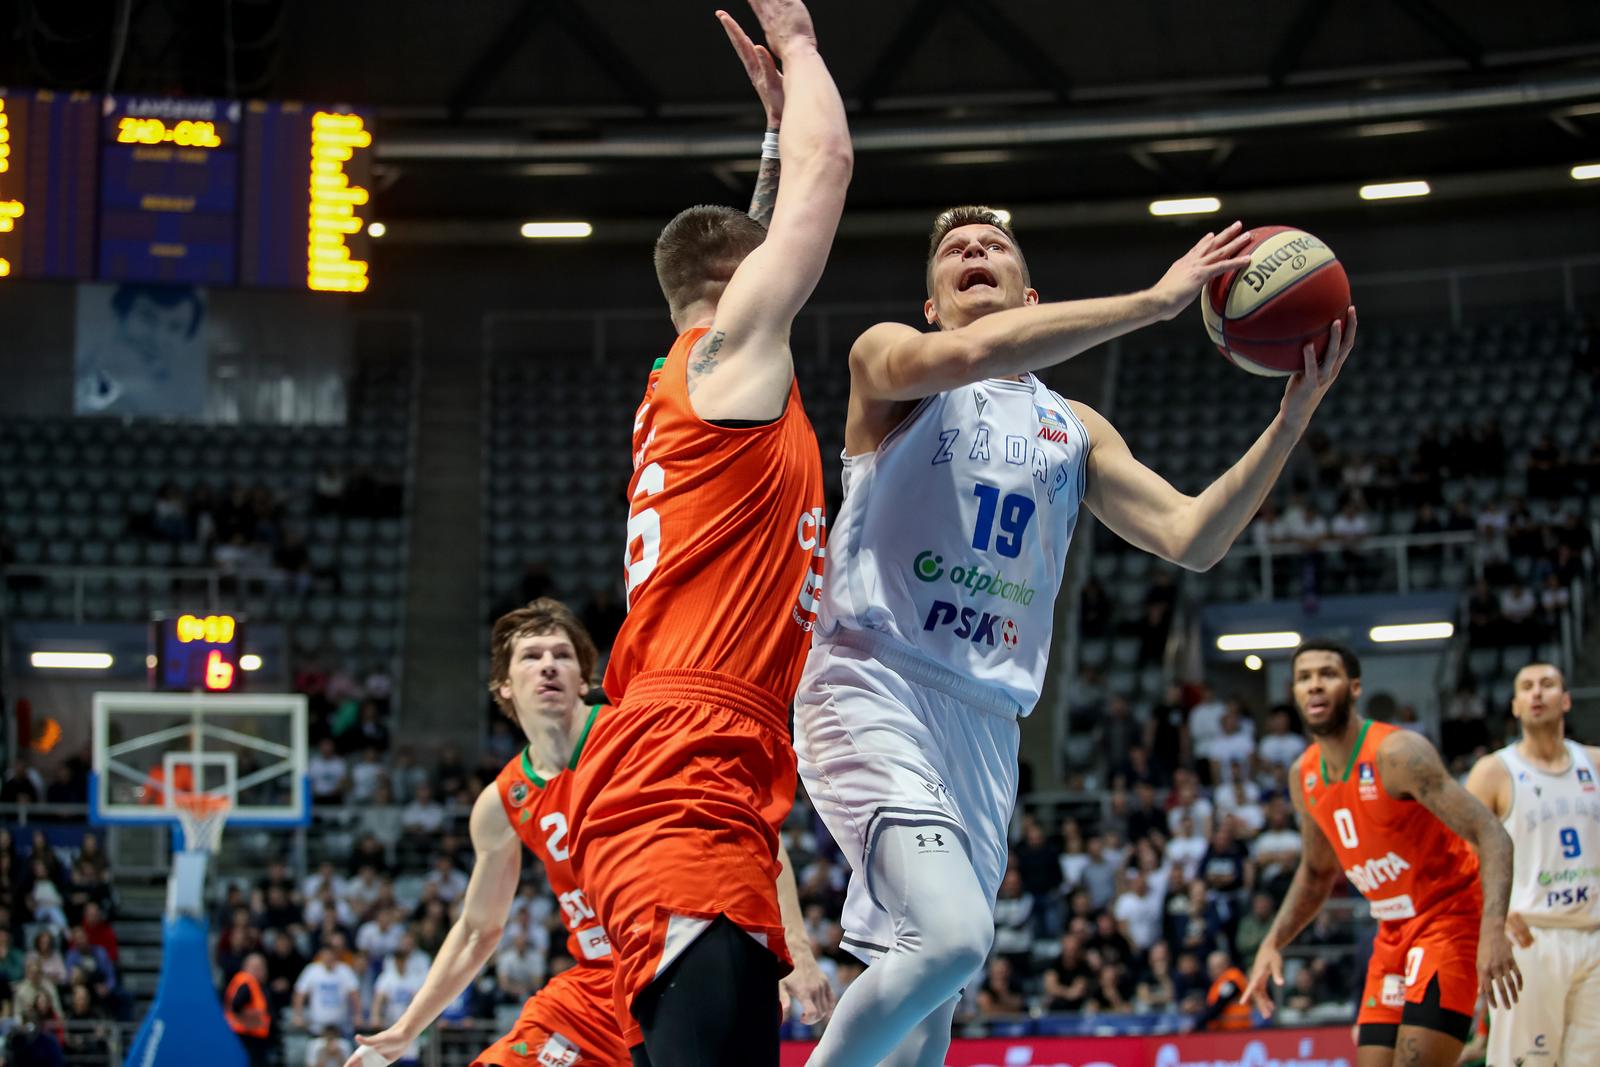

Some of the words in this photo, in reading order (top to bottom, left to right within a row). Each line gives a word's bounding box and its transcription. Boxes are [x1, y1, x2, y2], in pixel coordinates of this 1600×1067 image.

[1037, 426, 1068, 445] AVIA
[971, 483, 1036, 559] 19
[923, 599, 1002, 646] PSK
[1333, 808, 1359, 849] 0
[1560, 826, 1581, 859] 9
[1546, 885, 1589, 908] PSK
